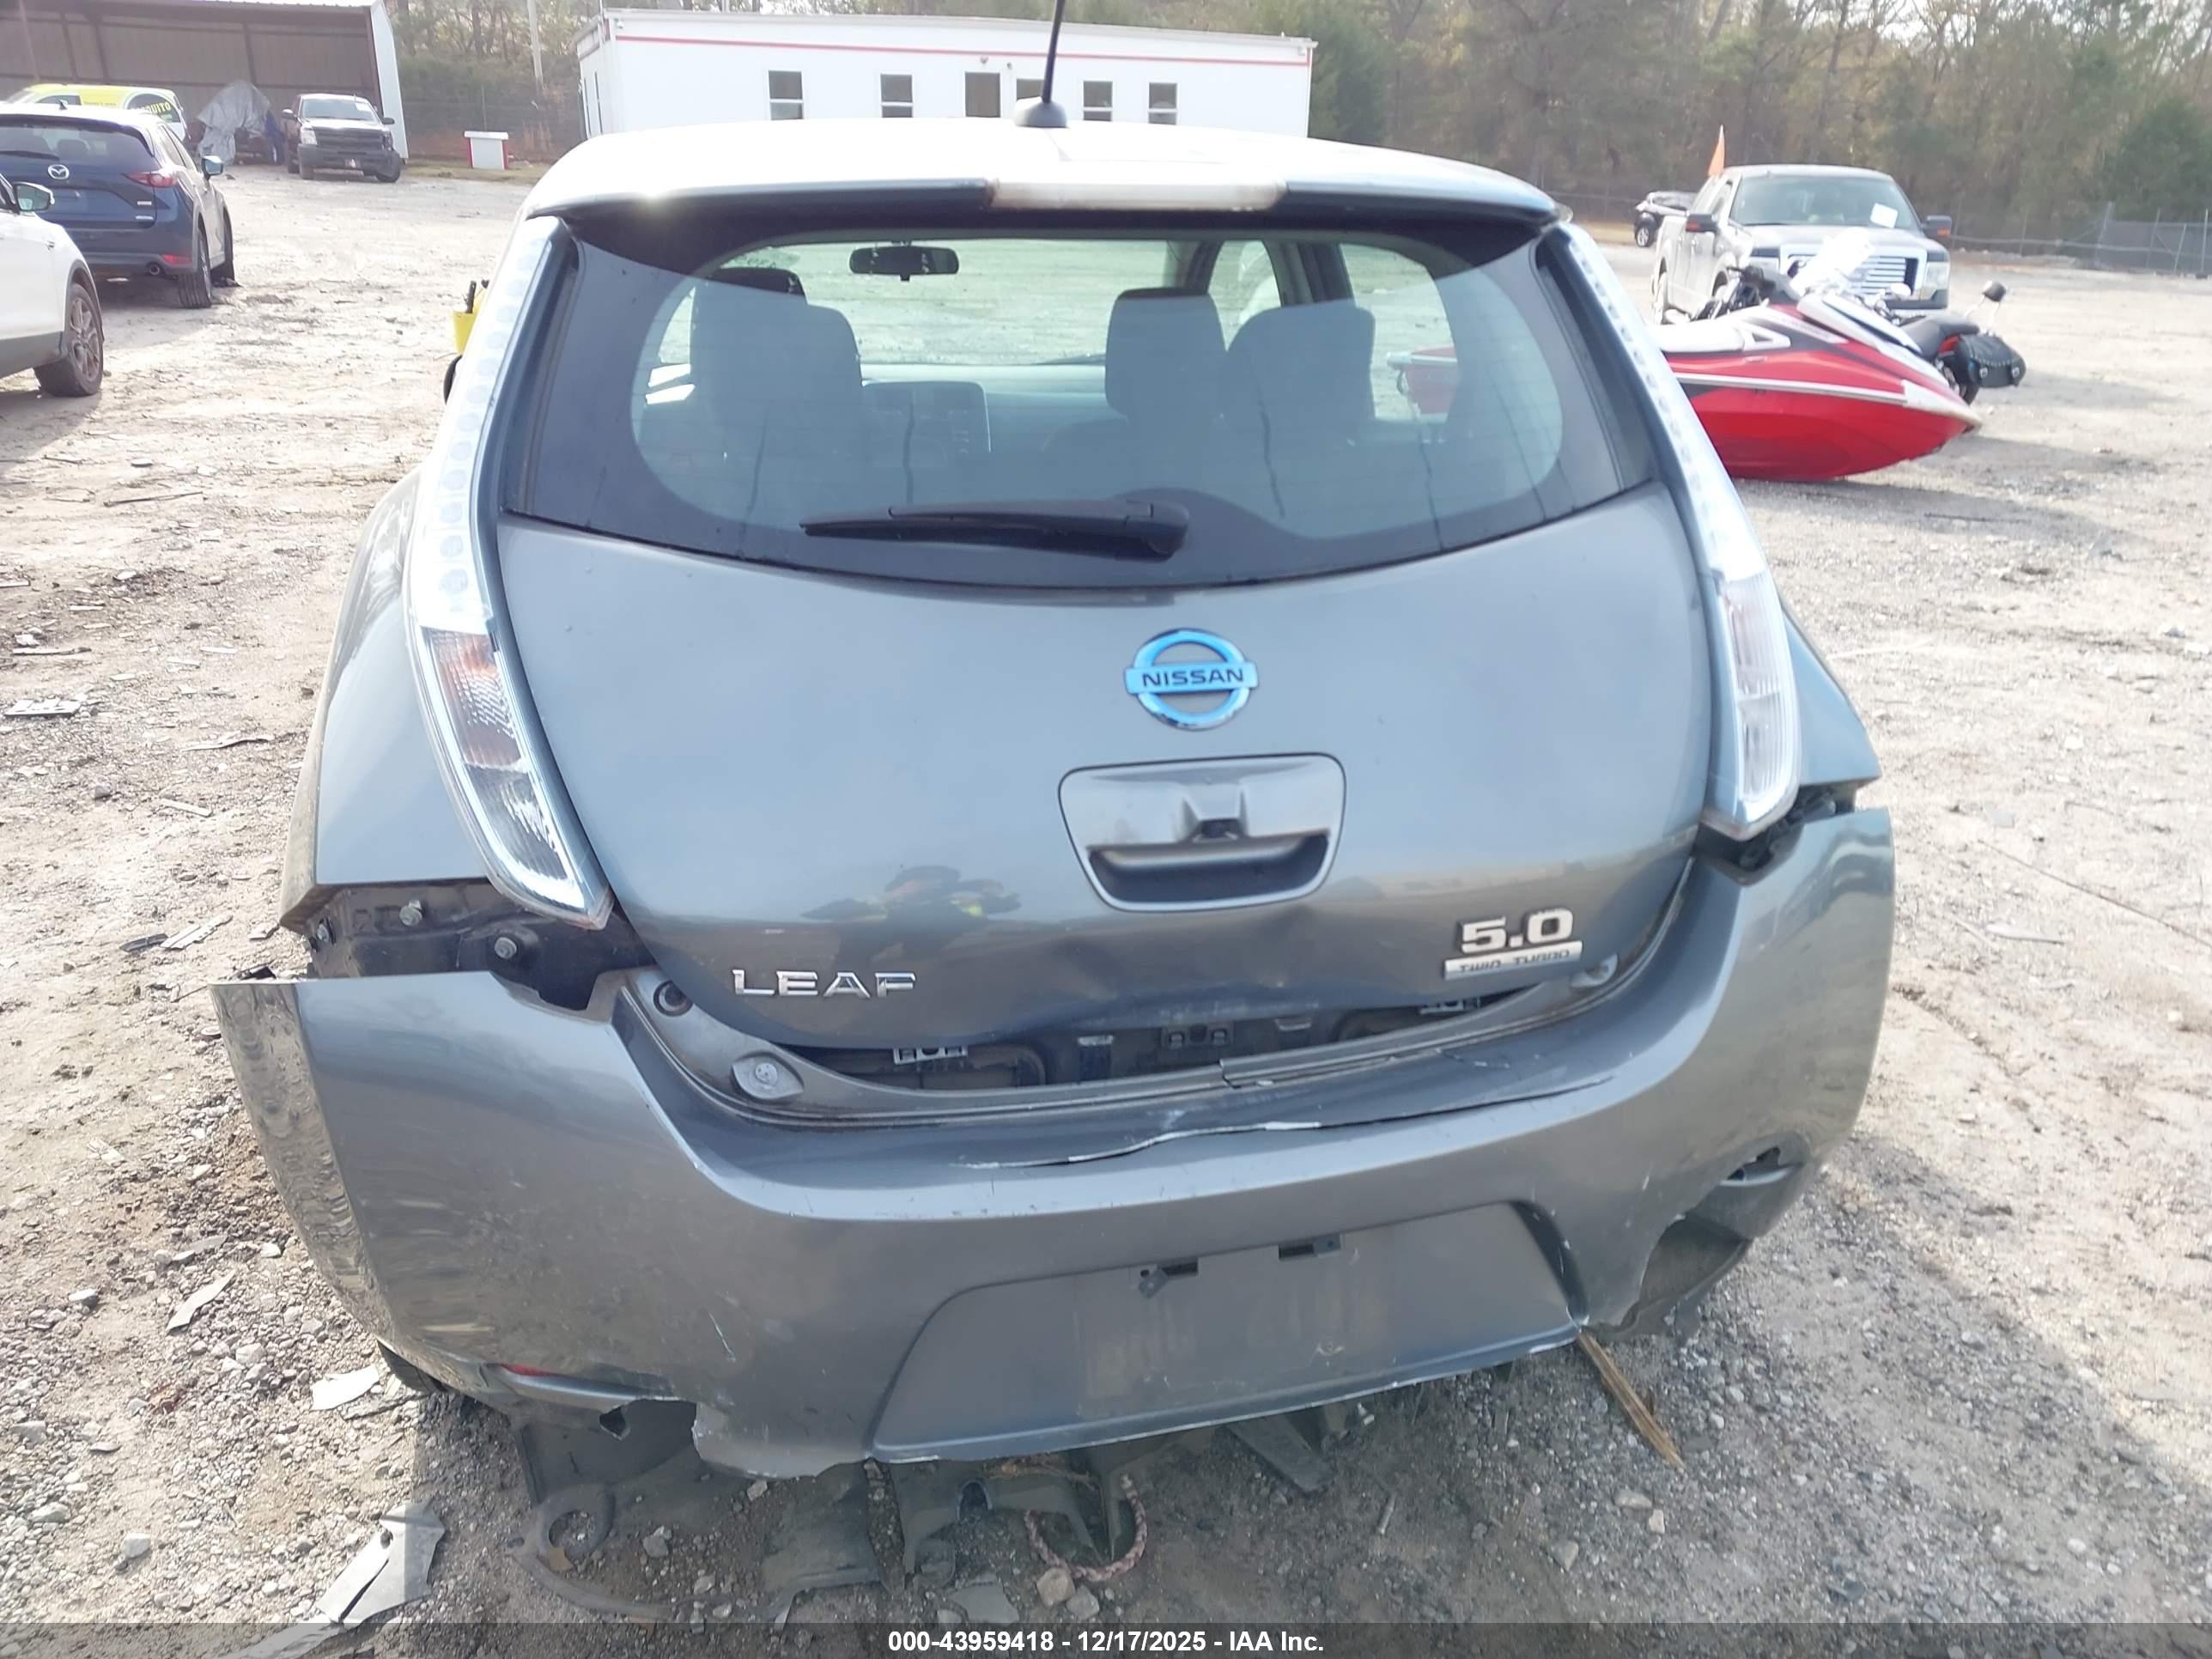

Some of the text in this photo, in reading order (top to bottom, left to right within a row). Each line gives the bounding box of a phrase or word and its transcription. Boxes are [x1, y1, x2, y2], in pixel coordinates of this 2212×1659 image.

[1142, 668, 1243, 687] NISSAN
[1461, 907, 1574, 954] 5.0
[732, 969, 916, 999] LEAF
